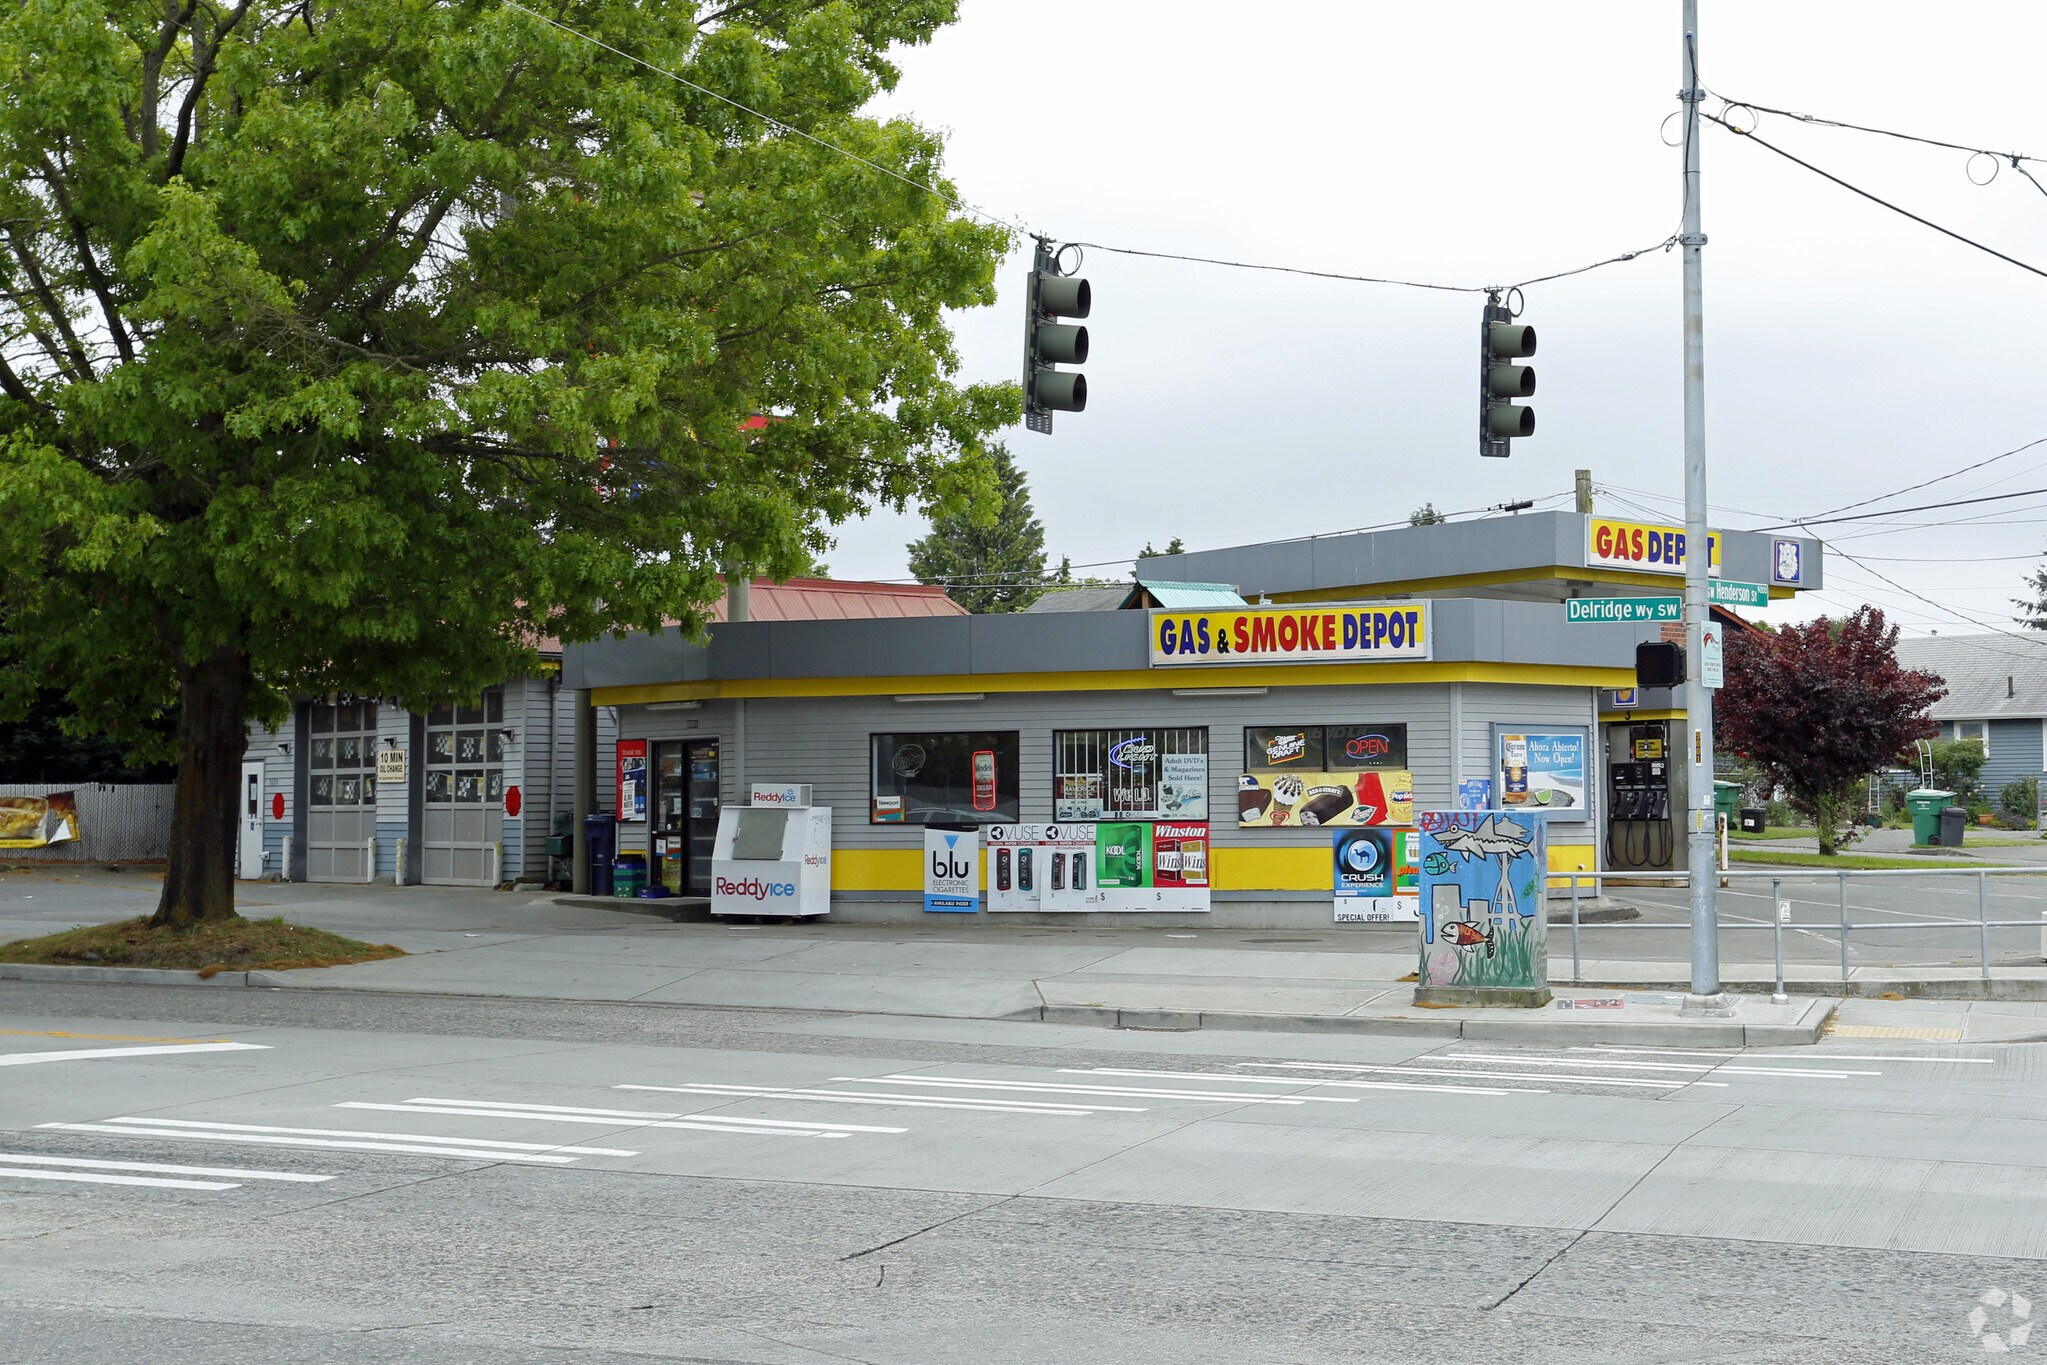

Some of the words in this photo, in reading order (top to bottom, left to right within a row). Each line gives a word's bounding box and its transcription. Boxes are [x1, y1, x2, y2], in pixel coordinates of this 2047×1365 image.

[1596, 525, 1643, 561] GAS
[1647, 530, 1714, 568] DEPT
[1716, 581, 1749, 602] Henderson
[1570, 601, 1631, 620] Delridge
[1635, 605, 1653, 619] Wy
[1658, 603, 1677, 616] SW
[1160, 617, 1210, 655] GAS
[1217, 628, 1230, 654] &
[1233, 614, 1336, 654] SMOKE
[1343, 610, 1418, 650] DEPOT
[1266, 739, 1306, 755] GENUINE
[1272, 746, 1300, 759] DRAFT
[1346, 739, 1389, 755] OPEN
[1505, 742, 1526, 751] Corona
[1529, 741, 1549, 752] Ahora
[1551, 741, 1580, 752] Abierto!
[380, 752, 388, 763] 10
[389, 752, 403, 763] MIN
[1534, 752, 1550, 763] Now
[1553, 753, 1575, 767] Open!
[387, 764, 403, 773] CHANGE
[1171, 766, 1206, 774] Magazines
[1003, 825, 1039, 840] VUSE
[1058, 825, 1094, 840] VUSE
[1155, 825, 1206, 838] Winston
[1106, 845, 1126, 855] KOOL
[932, 850, 969, 879] blu
[1341, 873, 1384, 882] CRUSH
[932, 886, 970, 894] CIGARETTES
[1100, 892, 1106, 901] $
[1156, 892, 1161, 901] $
[1397, 901, 1402, 910] $
[1337, 913, 1365, 921] SPECIAL
[1366, 913, 1390, 921] OFFER!
